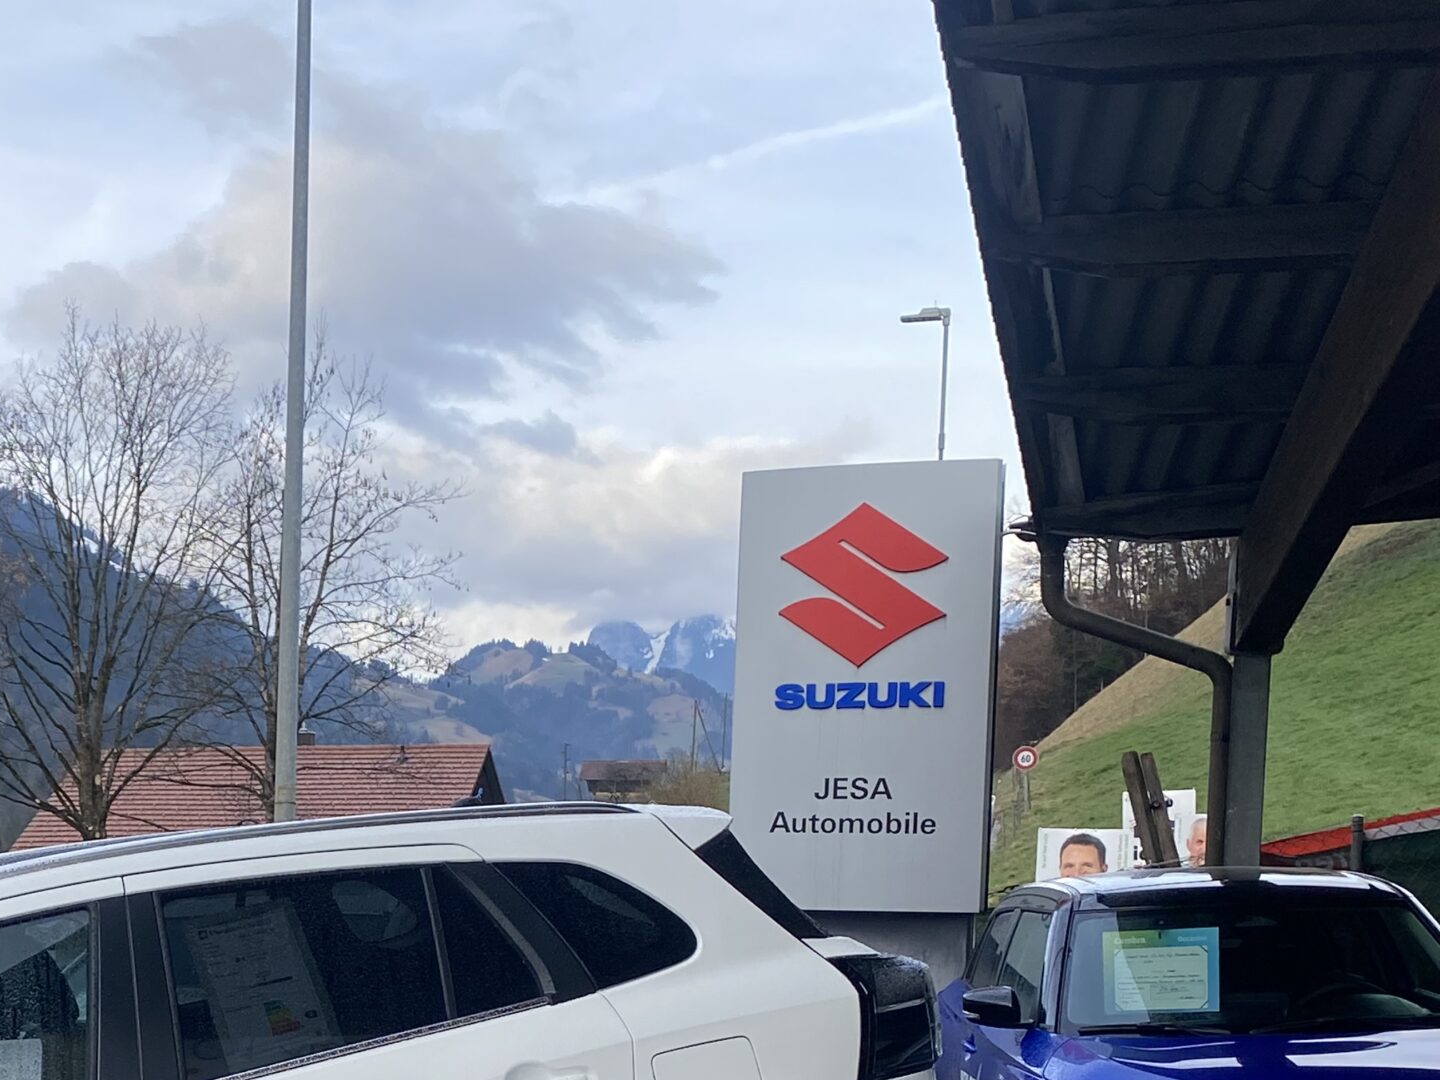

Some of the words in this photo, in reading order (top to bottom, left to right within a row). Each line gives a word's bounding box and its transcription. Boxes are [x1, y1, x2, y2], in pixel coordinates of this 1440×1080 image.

[774, 681, 945, 711] SUZUKI
[1020, 754, 1031, 763] 60
[814, 777, 893, 800] JESA
[769, 811, 937, 835] Automobile
